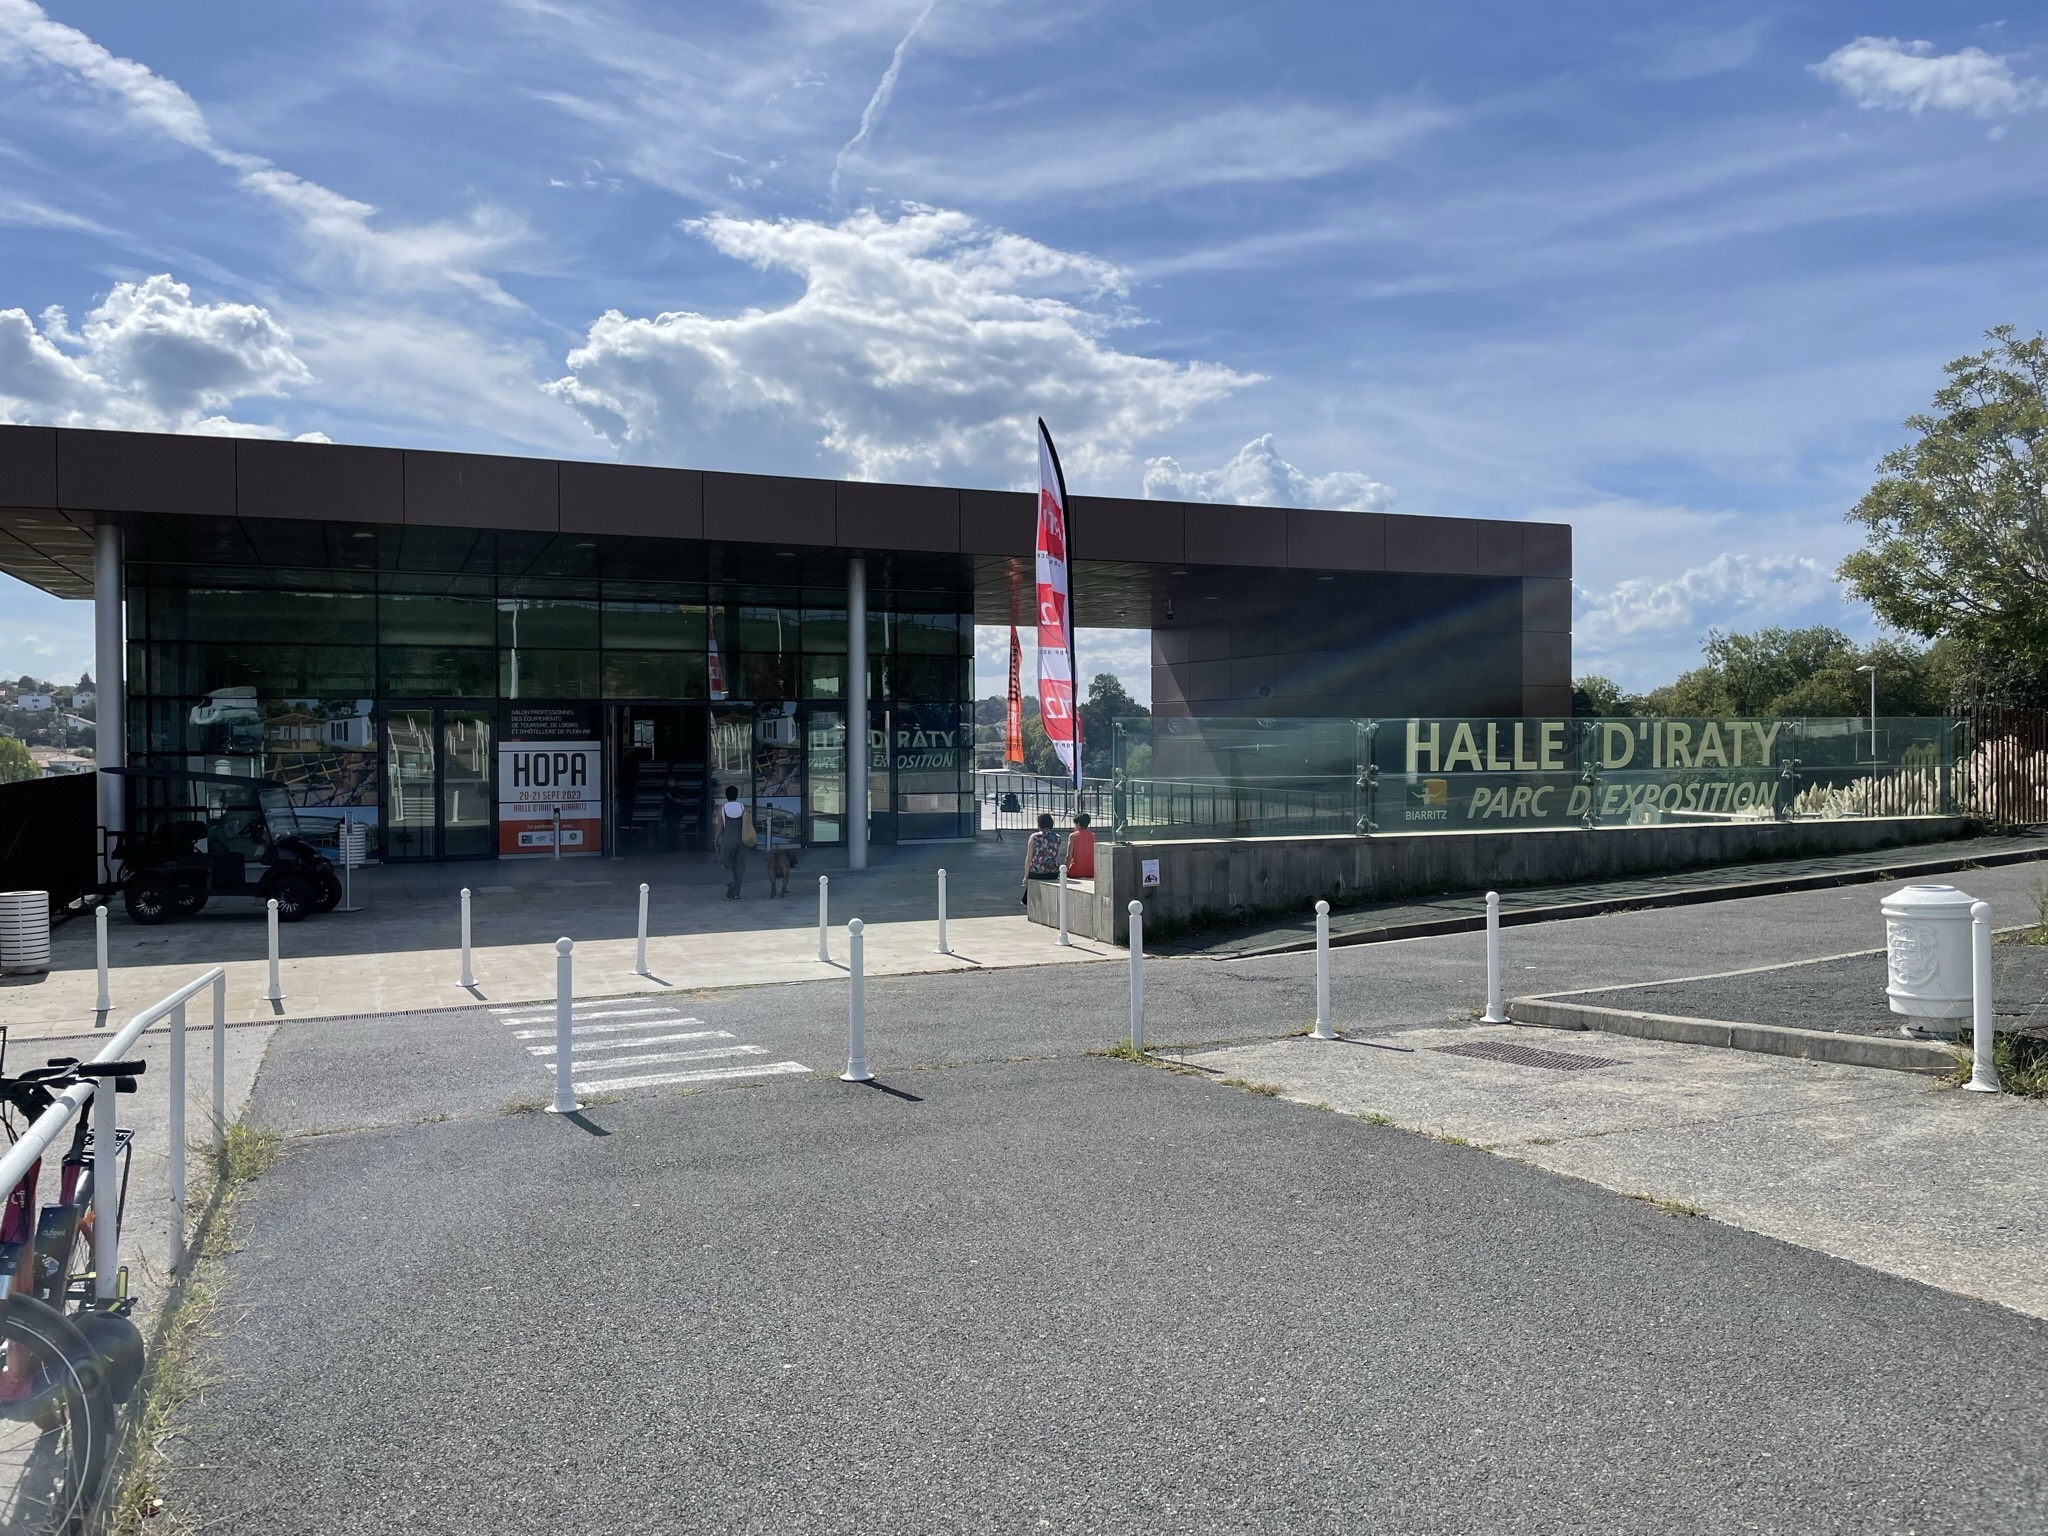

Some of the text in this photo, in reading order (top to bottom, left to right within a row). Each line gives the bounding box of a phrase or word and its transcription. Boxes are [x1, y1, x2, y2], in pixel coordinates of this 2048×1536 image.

[1405, 721, 1782, 772] HALLE D'IRATY
[513, 752, 587, 787] HOPA
[519, 790, 581, 800] 20-21 SEPT 2023
[1467, 781, 1779, 819] PARC D'EXPOSITION
[513, 803, 587, 812] HALLE D'IRATY BIARRITZ
[1405, 809, 1447, 821] BIARRITZ
